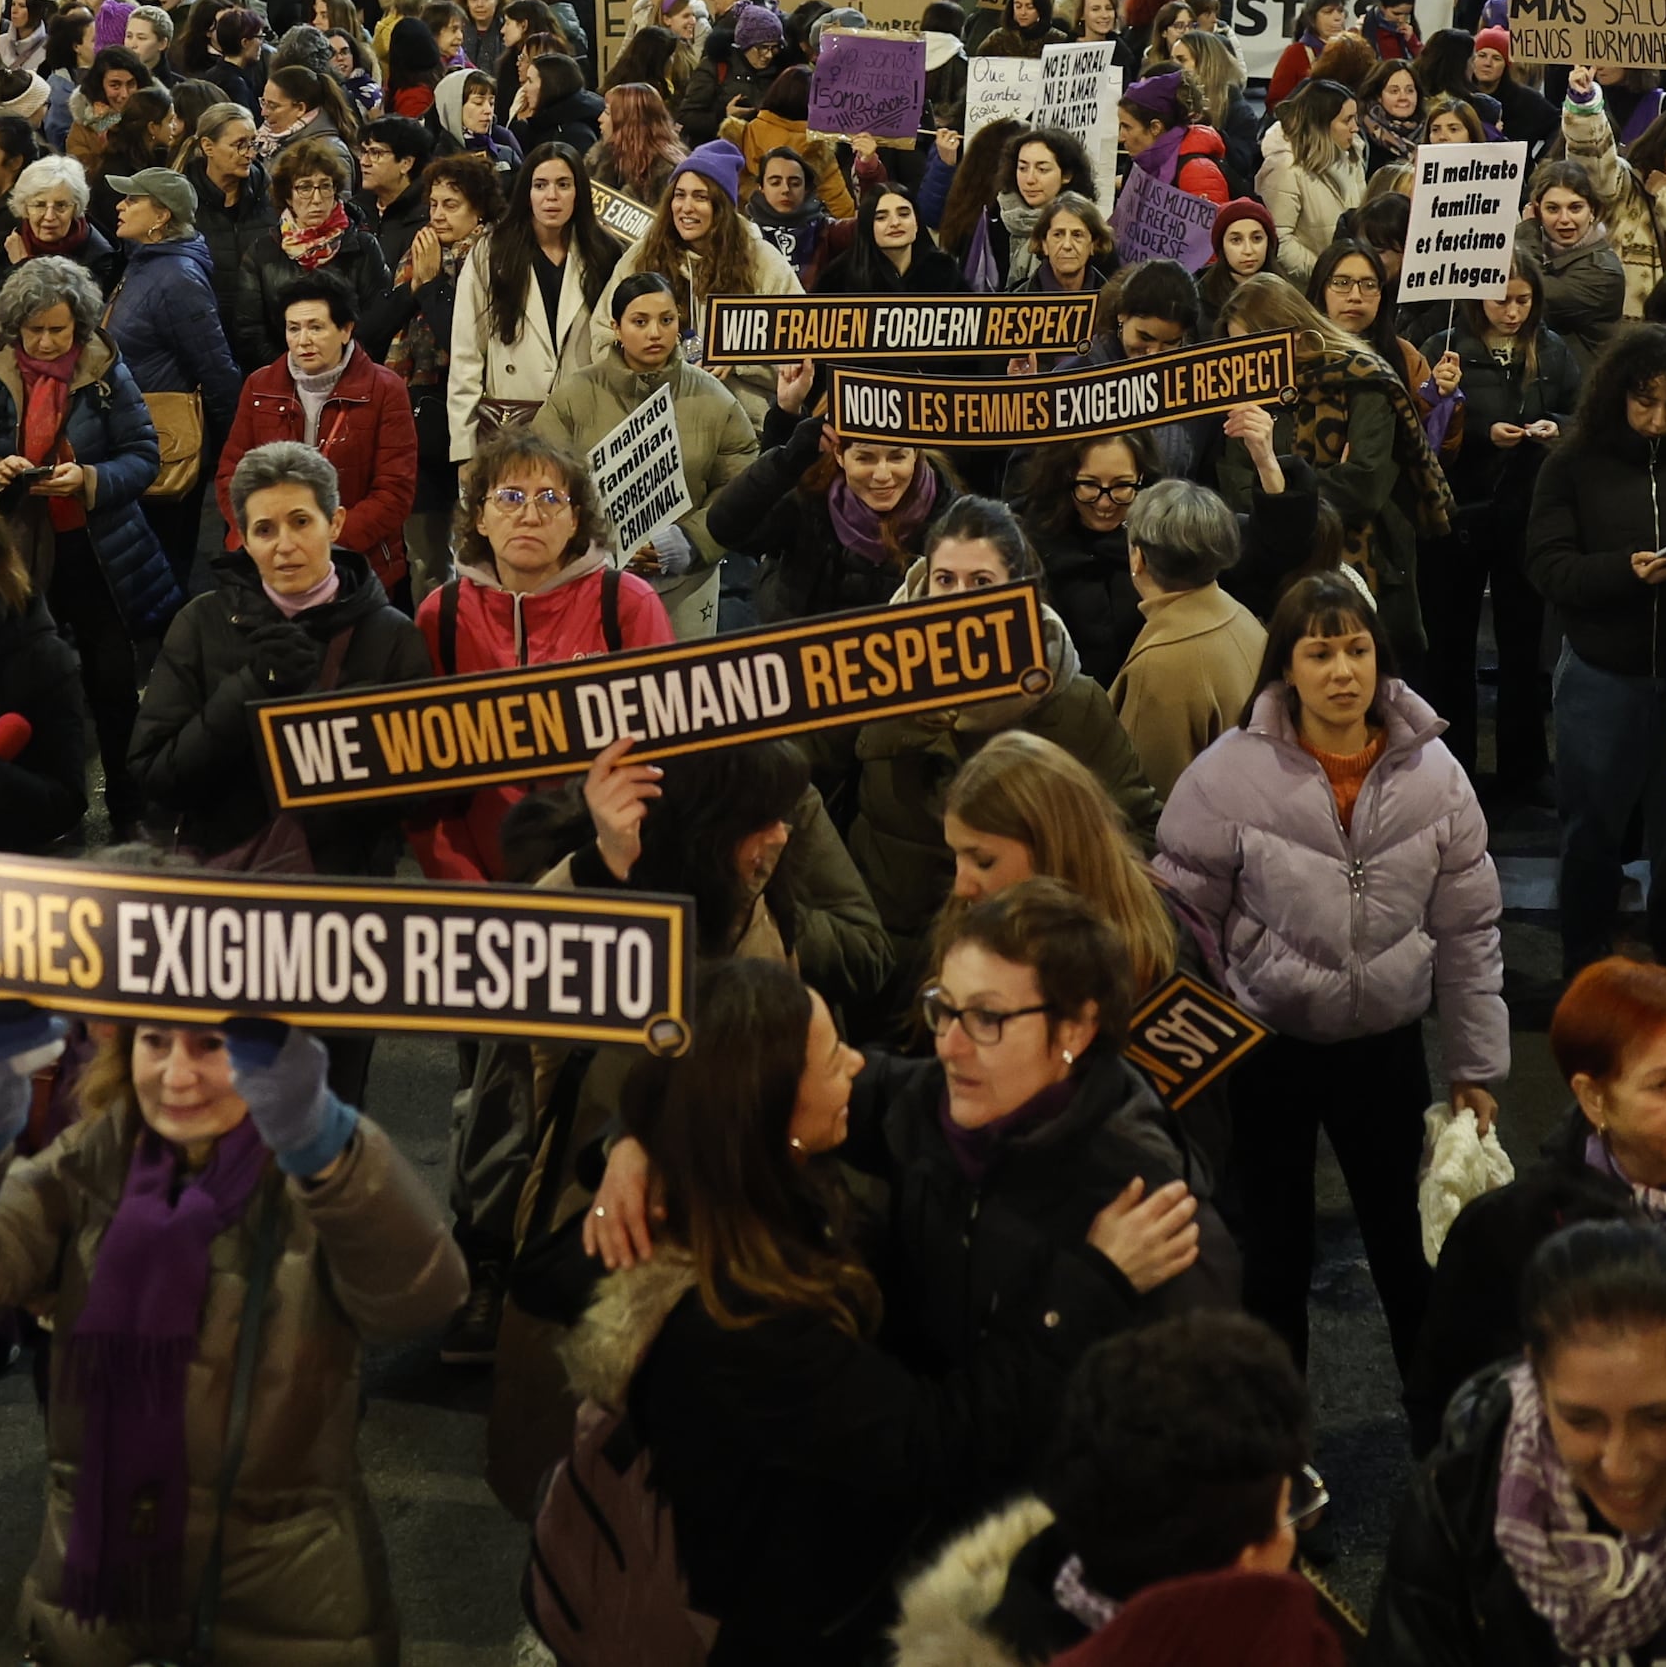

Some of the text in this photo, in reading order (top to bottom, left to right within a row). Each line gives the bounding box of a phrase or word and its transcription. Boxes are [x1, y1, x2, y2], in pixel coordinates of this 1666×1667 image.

[1509, 28, 1573, 60] MENOS
[865, 49, 913, 73] SOMOS
[973, 57, 1033, 84] Que la
[1042, 48, 1107, 79] NO ES MORAL,
[980, 86, 1022, 103] cambie
[1043, 76, 1098, 105] NI ES AMAR,
[1050, 101, 1098, 130] MALTRATO
[1421, 158, 1518, 185] El maltrato
[602, 198, 654, 239] EXIGIM
[1137, 200, 1187, 241] ERECHO
[1163, 191, 1216, 230] MUJERE
[1430, 193, 1501, 219] familiar
[1415, 227, 1506, 254] es fascismo
[1406, 261, 1506, 289] en el hogar.
[721, 303, 1089, 352] WIR FRAUEN FORDERN RESPEKT
[844, 347, 1283, 435] NOUS LES FEMMES EXIGEONS LE RESPECT
[592, 393, 668, 472] El maltrato
[597, 422, 673, 498] familiar,
[619, 479, 685, 552] CRIMINAL.
[282, 608, 1019, 787] WE WOMEN DEMAND RESPECT
[116, 900, 388, 1006] EXIGIMOS
[403, 914, 655, 1021] RESPETO
